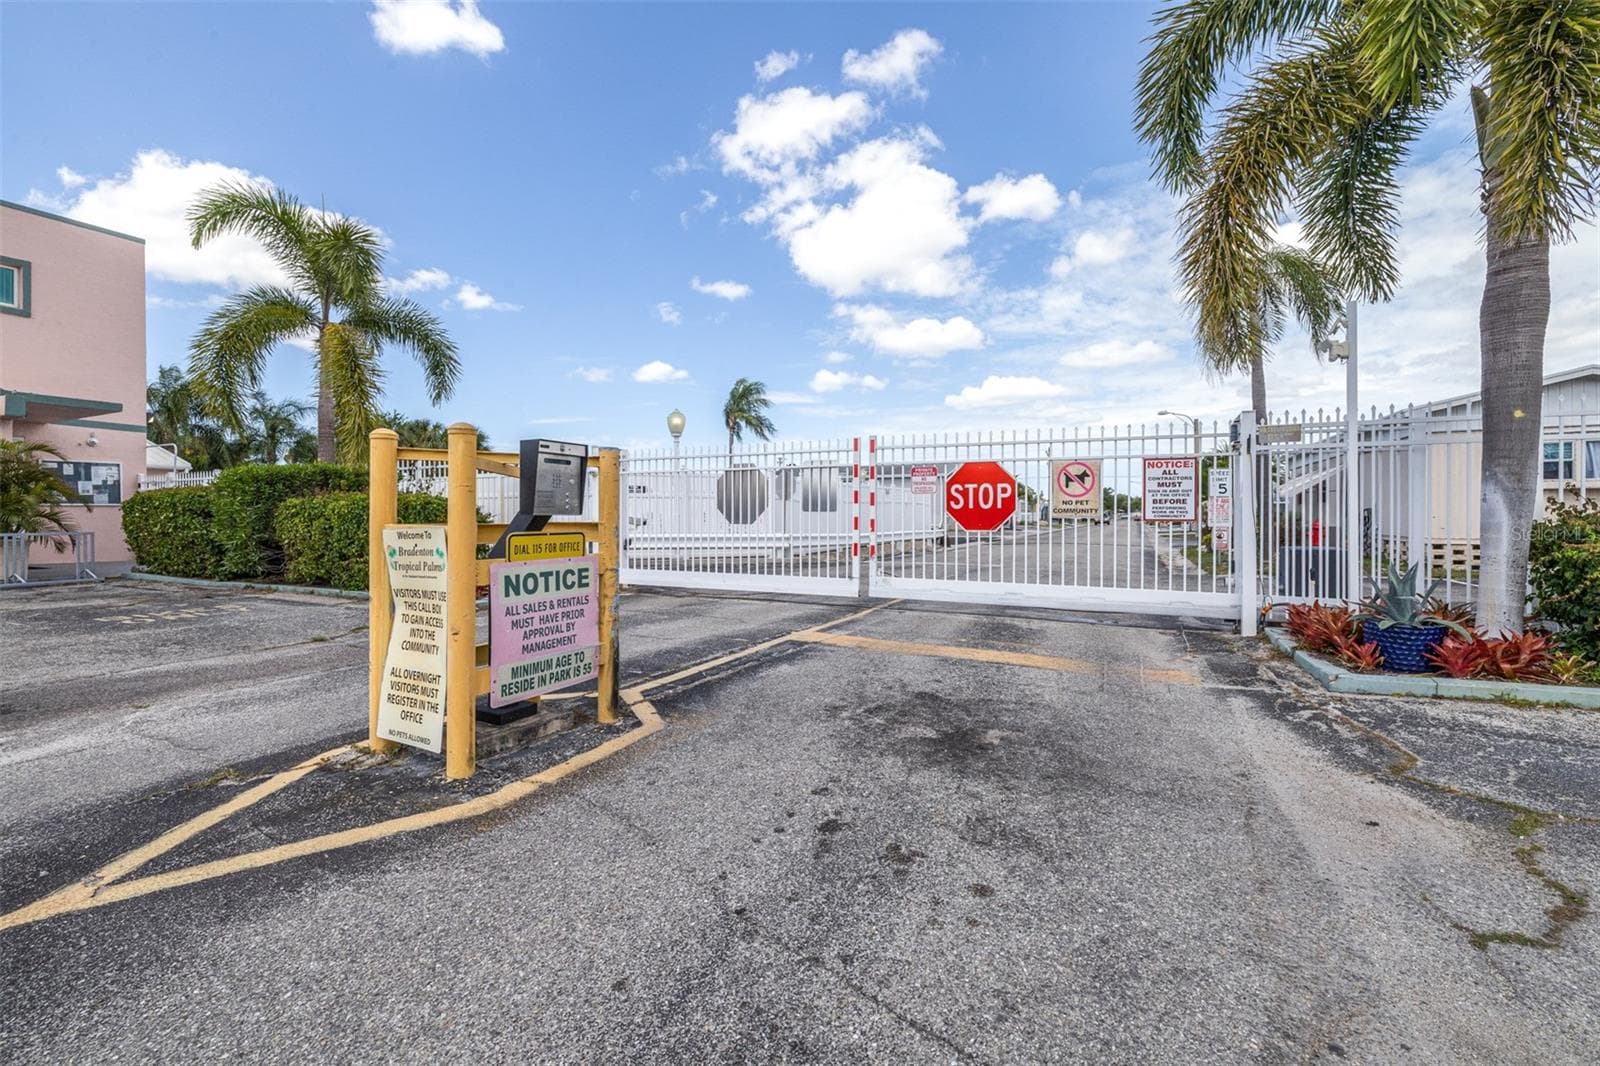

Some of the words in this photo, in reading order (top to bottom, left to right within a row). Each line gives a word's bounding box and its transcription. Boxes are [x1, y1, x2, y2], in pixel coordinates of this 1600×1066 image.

[950, 483, 1012, 509] STOP
[1218, 484, 1227, 494] 5
[397, 531, 424, 540] Welcome
[424, 531, 432, 539] To
[398, 545, 434, 557] Bradenton
[514, 544, 530, 555] DIAL
[532, 543, 542, 554] 115
[545, 542, 557, 553] FOR
[559, 542, 580, 552] OFFICE
[394, 561, 421, 573] Tropical
[423, 561, 442, 572] Palms
[504, 568, 590, 598] NOTICE
[393, 588, 421, 599] VISITORS
[421, 590, 437, 600] MUST
[438, 591, 447, 602] USE
[404, 601, 417, 612] THIS
[418, 602, 431, 613] CALL
[432, 604, 442, 614] BOX
[505, 604, 521, 617] ALL
[522, 600, 547, 614] SALES
[549, 600, 555, 610] &
[558, 595, 590, 609] RENTALS
[402, 613, 409, 624] TO
[410, 614, 424, 626] GAIN
[425, 616, 443, 629] ACCESS
[511, 616, 535, 630] MUST
[539, 612, 560, 625] HAVE
[561, 609, 585, 623] PRIOR
[410, 628, 424, 639] INTO
[424, 630, 435, 640] THE
[522, 624, 564, 641] APPROVAL
[566, 621, 576, 633] BY
[401, 640, 440, 655] COMMUNITY
[522, 634, 577, 655] MANAGEMENT
[511, 658, 553, 680] MINIMUM
[554, 654, 572, 668] AGE
[574, 651, 585, 664] TO
[390, 667, 402, 678] ALL
[403, 669, 441, 686] OVERNIGHT
[500, 678, 535, 698] RESIDE
[537, 674, 547, 687] IN
[549, 668, 571, 686] PARK
[573, 664, 581, 679] IS
[583, 662, 592, 675] 55
[390, 680, 420, 695] VISITORS
[420, 686, 439, 699] MUST
[387, 693, 418, 708] REGISTER
[419, 700, 426, 711] IN
[427, 701, 439, 714] THE
[400, 710, 423, 724] OFFICE
[388, 728, 396, 736] NO
[396, 730, 408, 740] PETS
[409, 733, 431, 746] ALLOWED
